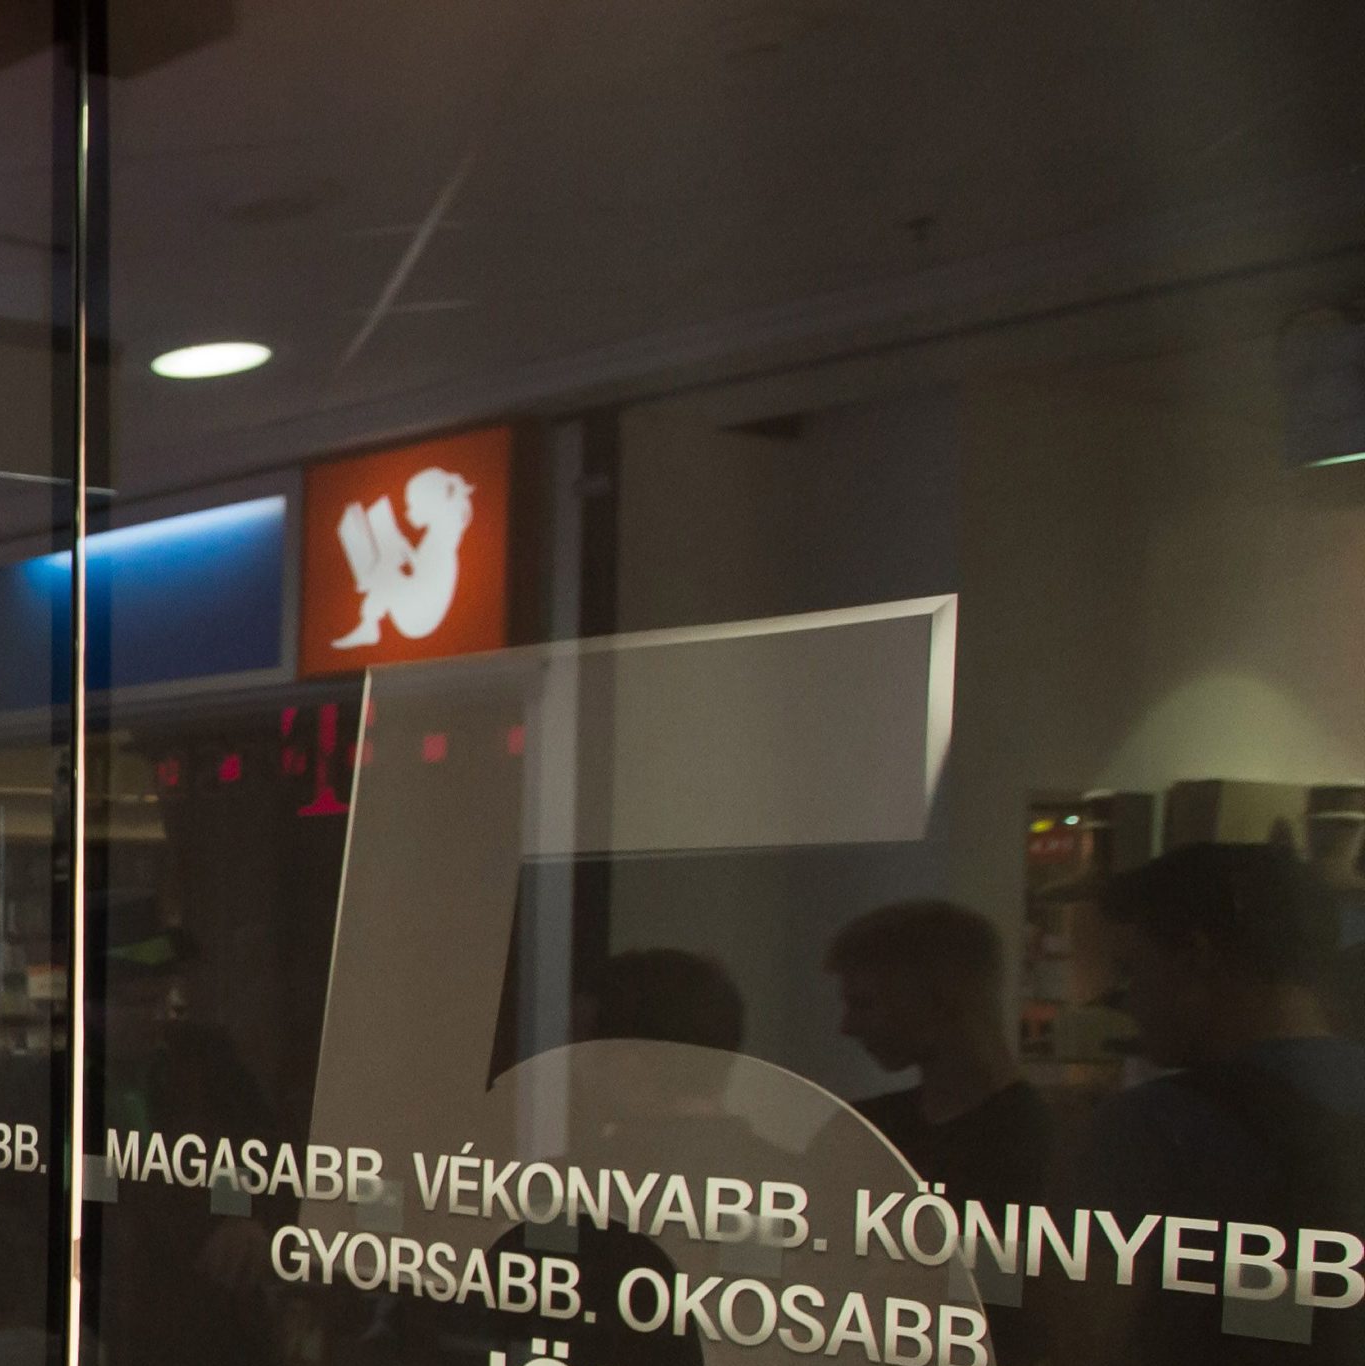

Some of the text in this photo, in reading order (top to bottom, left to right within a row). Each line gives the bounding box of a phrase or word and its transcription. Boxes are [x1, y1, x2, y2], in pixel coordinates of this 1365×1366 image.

[104, 1129, 1365, 1309] MAGASABB. VÉKONYABB. KÖNNYEBB
[270, 1225, 597, 1323] GYORSABB.
